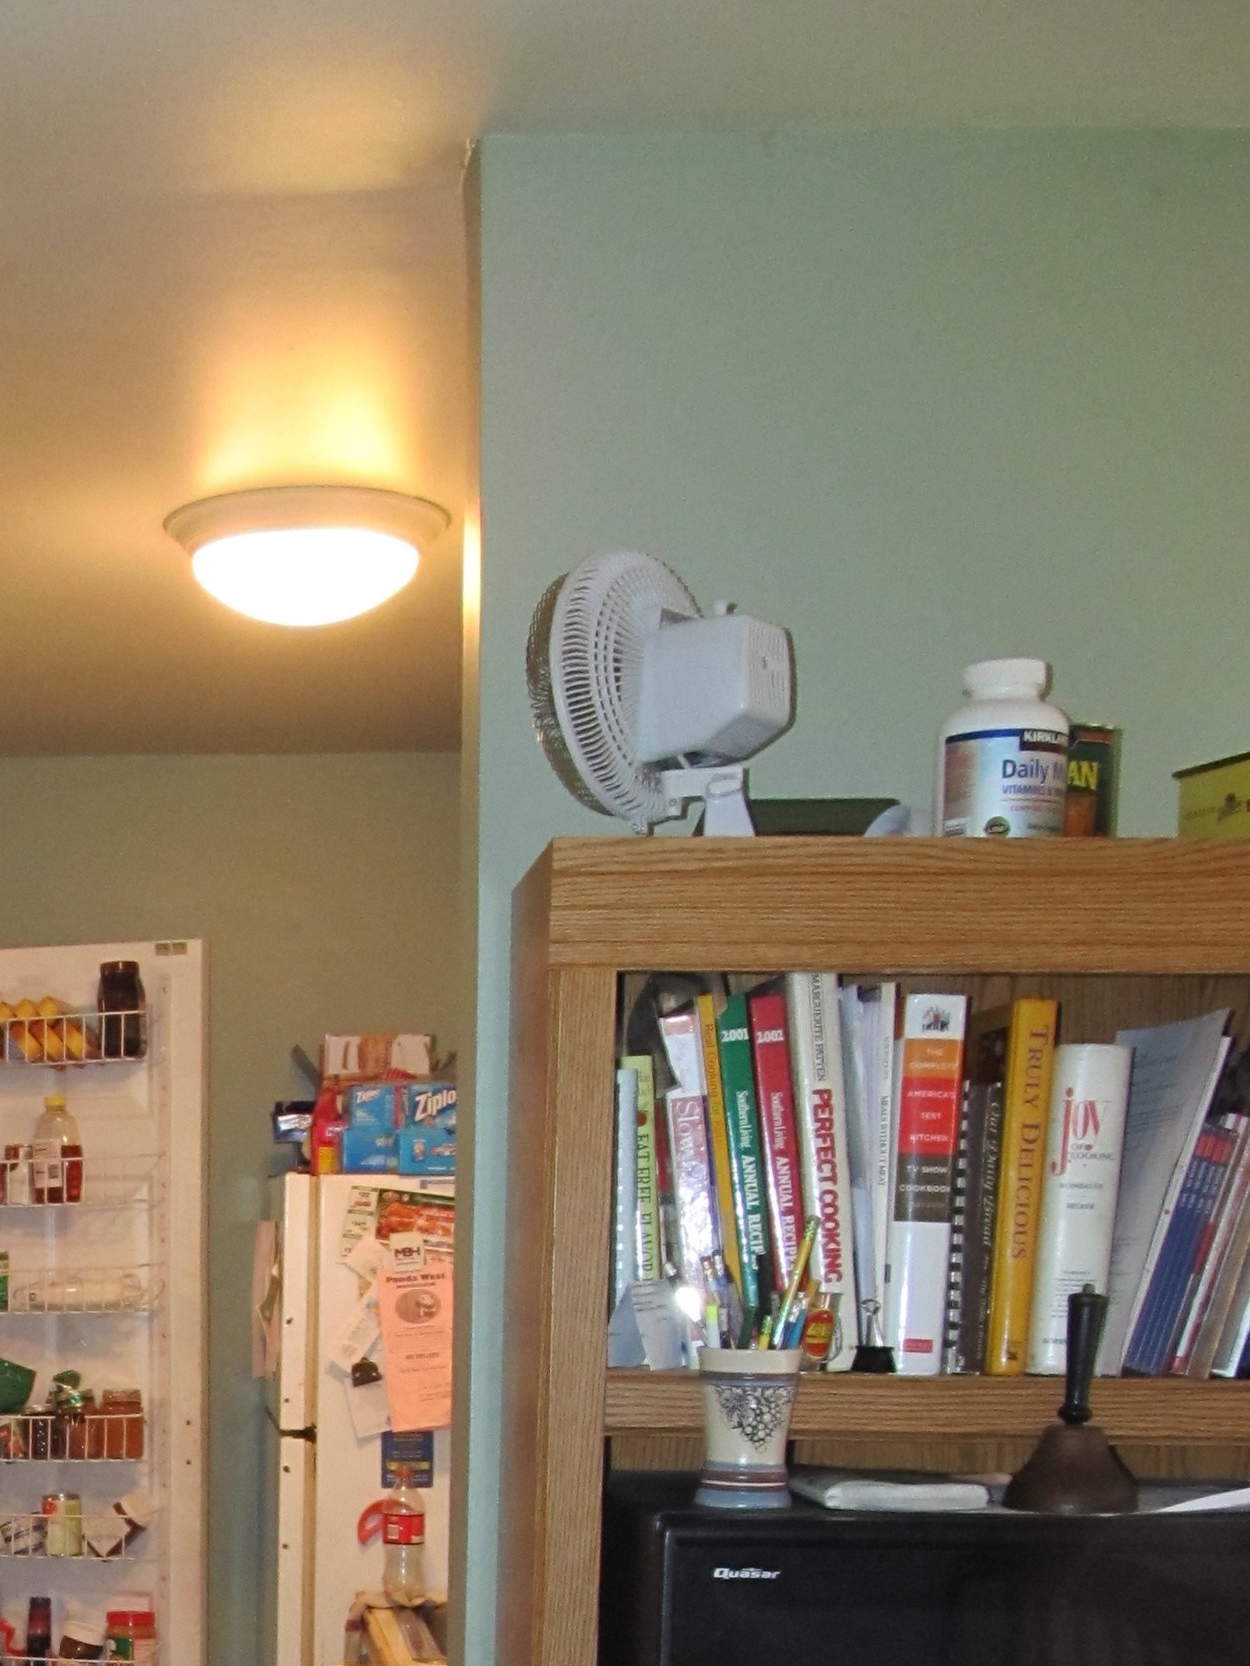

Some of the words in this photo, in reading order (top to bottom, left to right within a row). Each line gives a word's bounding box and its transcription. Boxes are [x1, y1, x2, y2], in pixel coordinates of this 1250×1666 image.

[1002, 759, 1049, 785] Daily
[1068, 760, 1100, 791] AN
[811, 973, 824, 1043] MARGUERITE
[720, 1027, 750, 1043] 2001
[756, 1028, 785, 1044] 2002
[815, 1042, 826, 1083] PATTEN
[926, 1048, 944, 1057] THE
[1024, 1024, 1049, 1110] TRULY
[414, 1088, 456, 1122] Ziplo
[907, 1090, 957, 1099] AMERICA'S
[920, 1112, 941, 1120] TEST
[812, 1088, 839, 1186] PERFECT
[909, 1134, 950, 1143] KITCHEN
[741, 1154, 761, 1211] ANNUAL
[775, 1155, 795, 1212] ANNUAL
[906, 1165, 918, 1174] TV
[922, 1165, 950, 1174] SHOW
[899, 1184, 951, 1193] COOKBOOK
[1012, 1122, 1042, 1260] DELICIOUS
[818, 1188, 844, 1284] COOKING
[713, 1567, 781, 1580] Quasar
